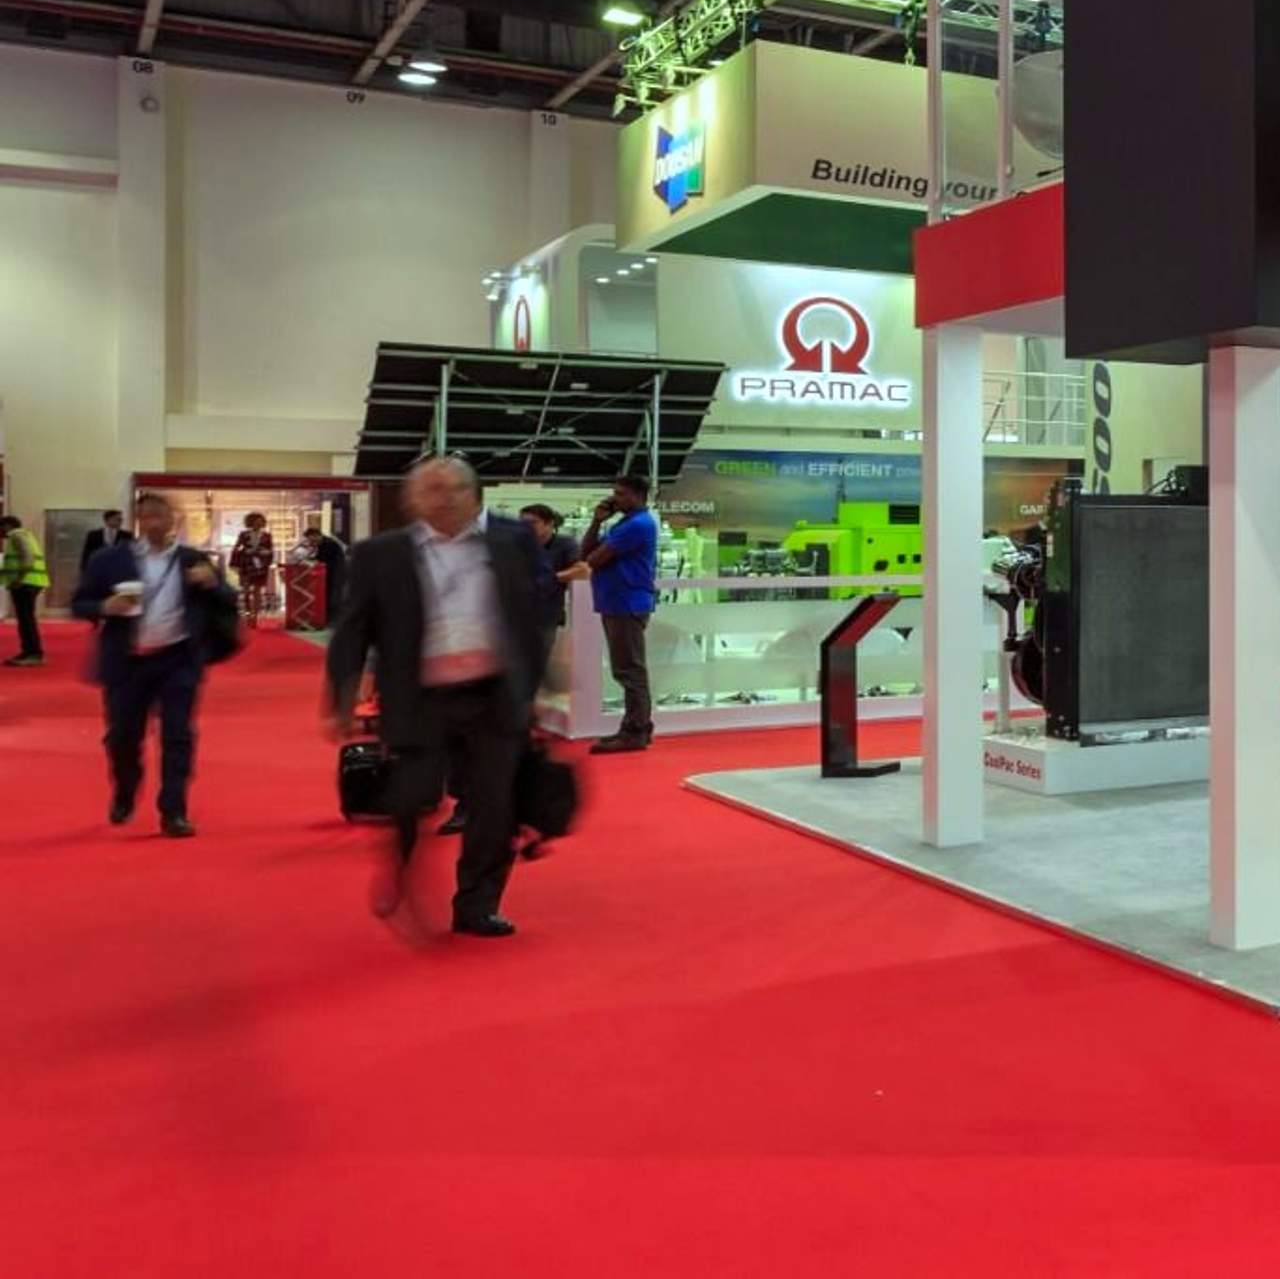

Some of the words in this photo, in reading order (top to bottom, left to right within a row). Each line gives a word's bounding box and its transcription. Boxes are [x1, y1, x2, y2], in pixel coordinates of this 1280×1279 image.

[541, 113, 557, 126] 10
[811, 159, 929, 198] Building
[740, 377, 909, 402] PRAMAC
[807, 461, 893, 477] EFFICIENT
